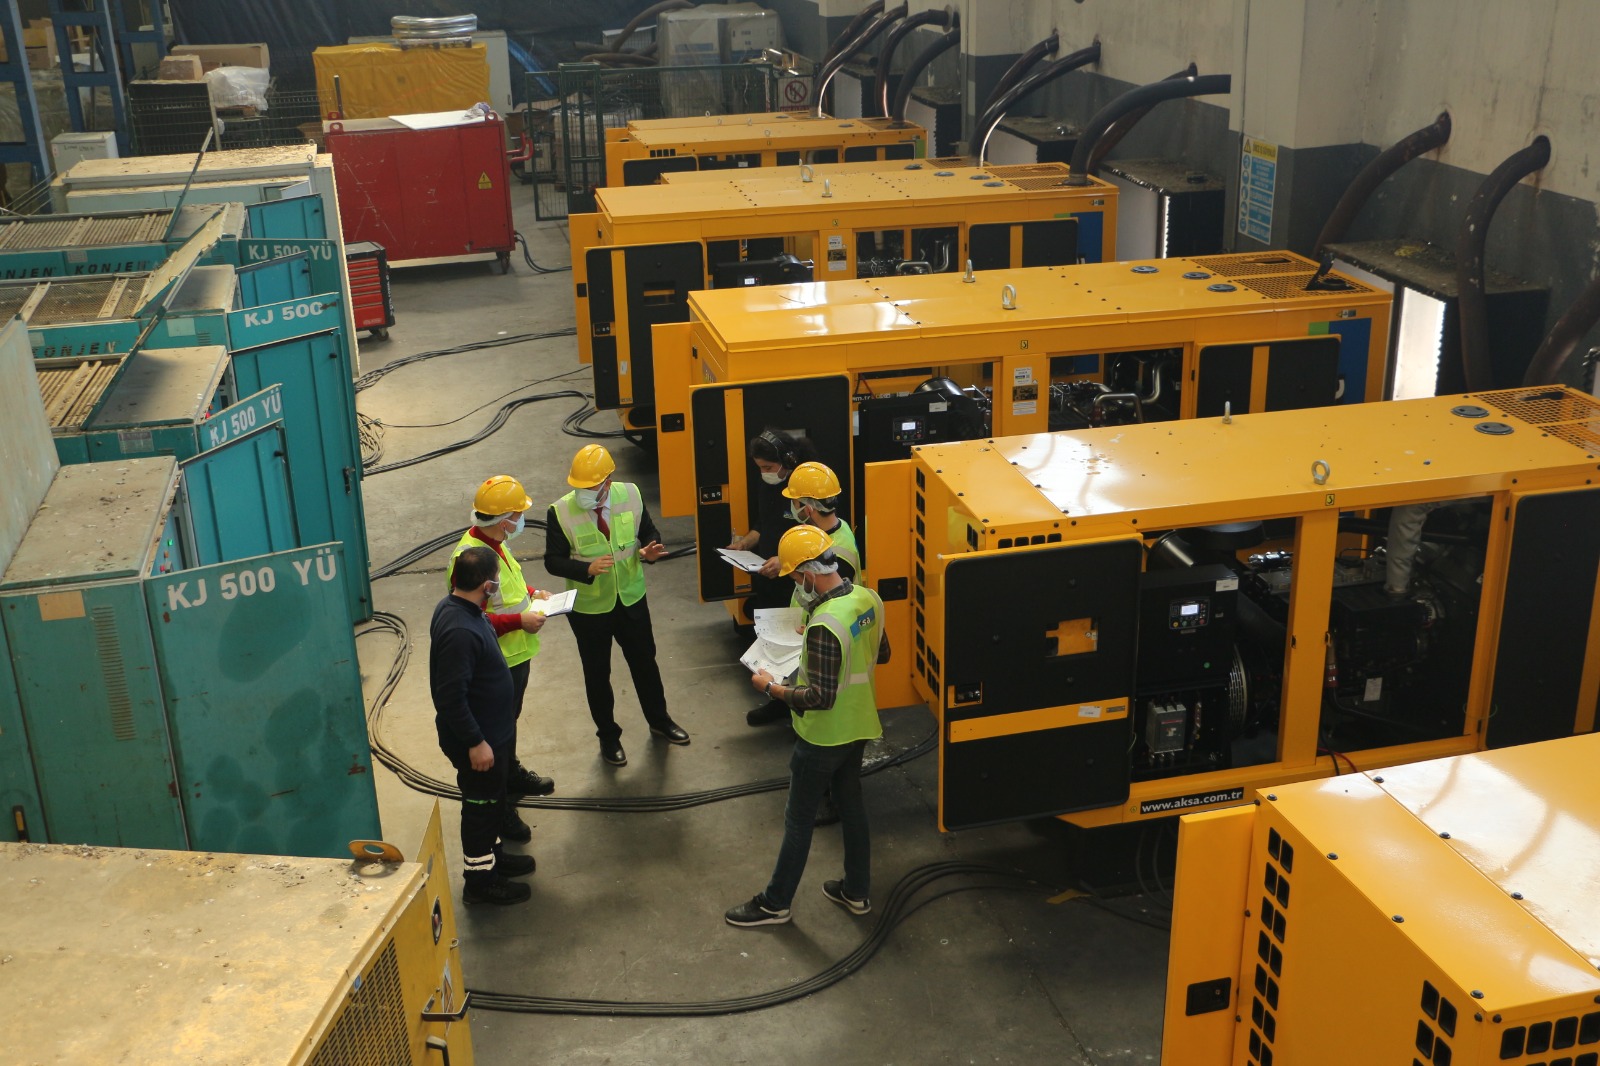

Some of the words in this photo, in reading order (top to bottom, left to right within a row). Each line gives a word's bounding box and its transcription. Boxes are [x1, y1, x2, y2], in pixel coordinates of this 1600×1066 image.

[248, 244, 269, 260] KJ
[309, 241, 332, 260] YÜ
[0, 267, 53, 279] NJEN
[244, 309, 274, 328] KJ
[210, 420, 228, 447] KJ
[231, 405, 256, 435] 500
[261, 387, 282, 418] YÜ
[167, 578, 208, 611] KJ
[220, 566, 276, 600] 500
[292, 547, 337, 586] YÜ
[1141, 790, 1242, 812] www.aksa.com.tr
